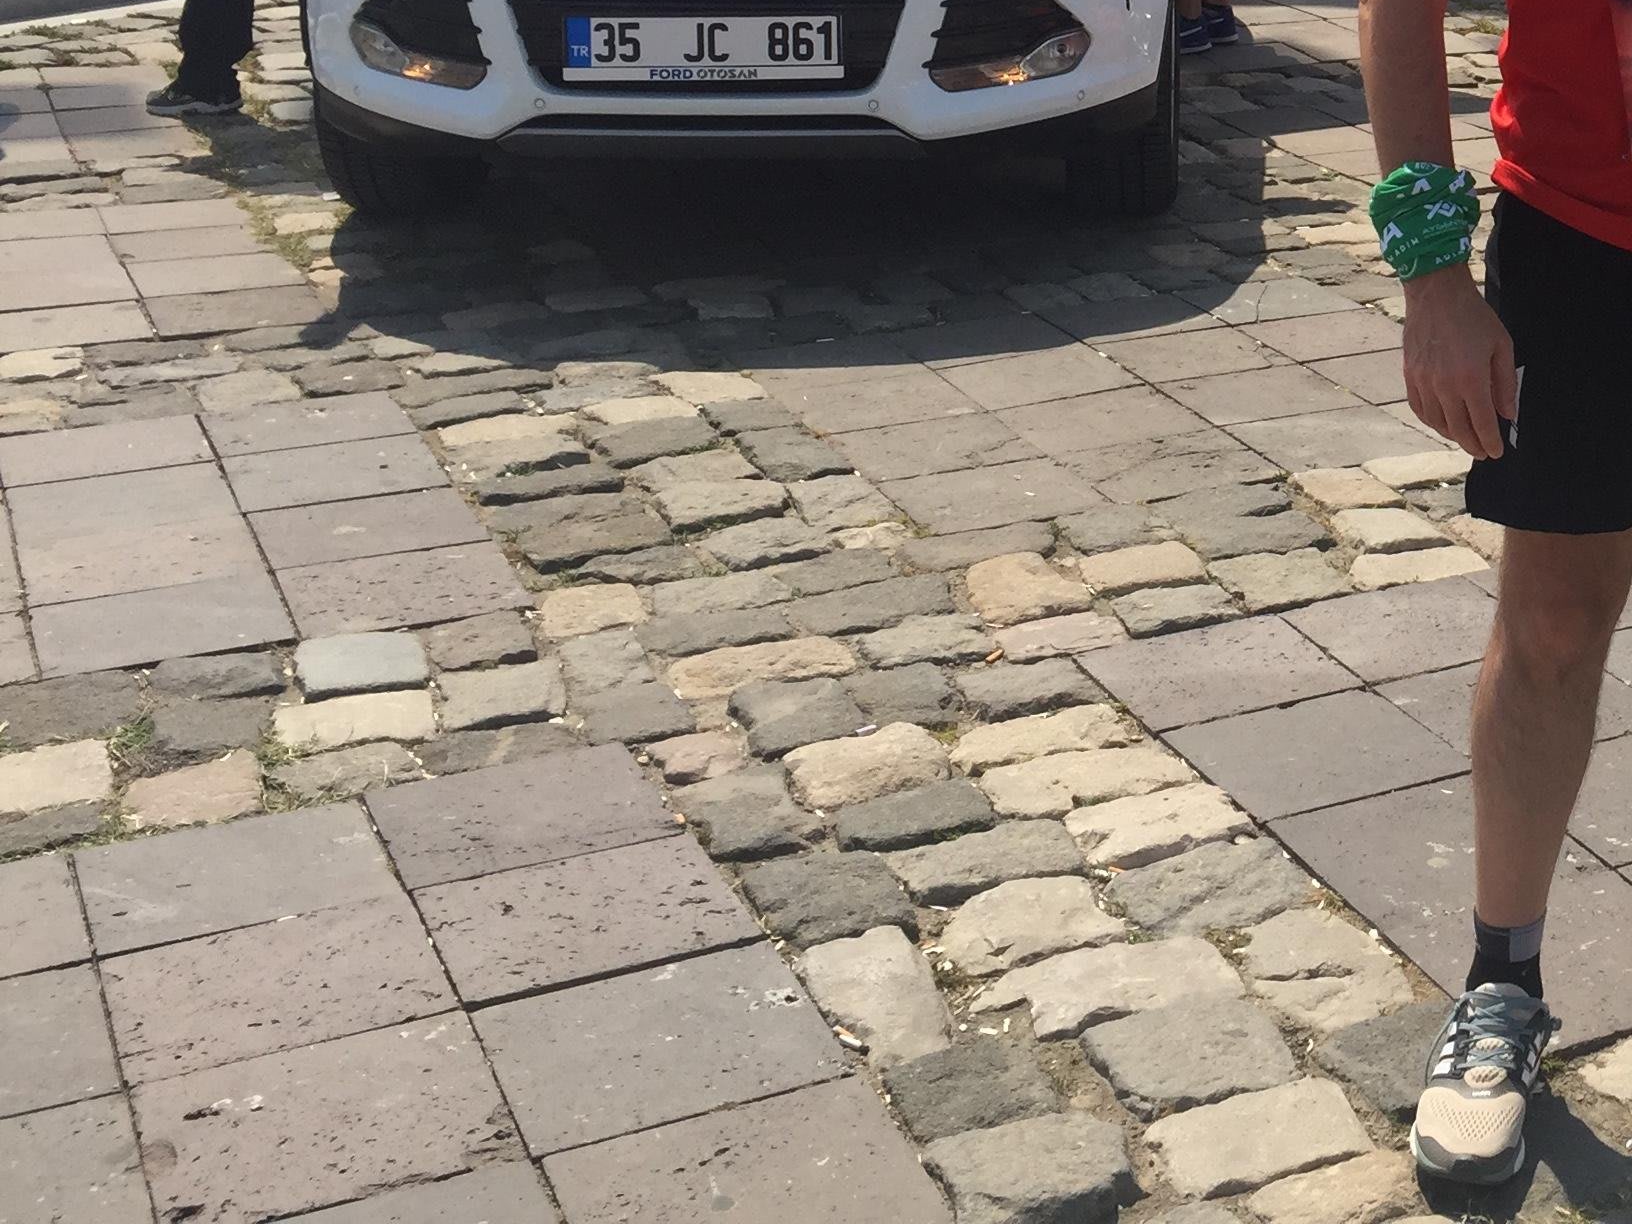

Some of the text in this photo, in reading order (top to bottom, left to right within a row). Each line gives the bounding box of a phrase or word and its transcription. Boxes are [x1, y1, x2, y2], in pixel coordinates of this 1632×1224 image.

[593, 20, 833, 63] 35 JC 861
[571, 45, 590, 58] TR
[650, 68, 758, 80] FORD OTOSAN
